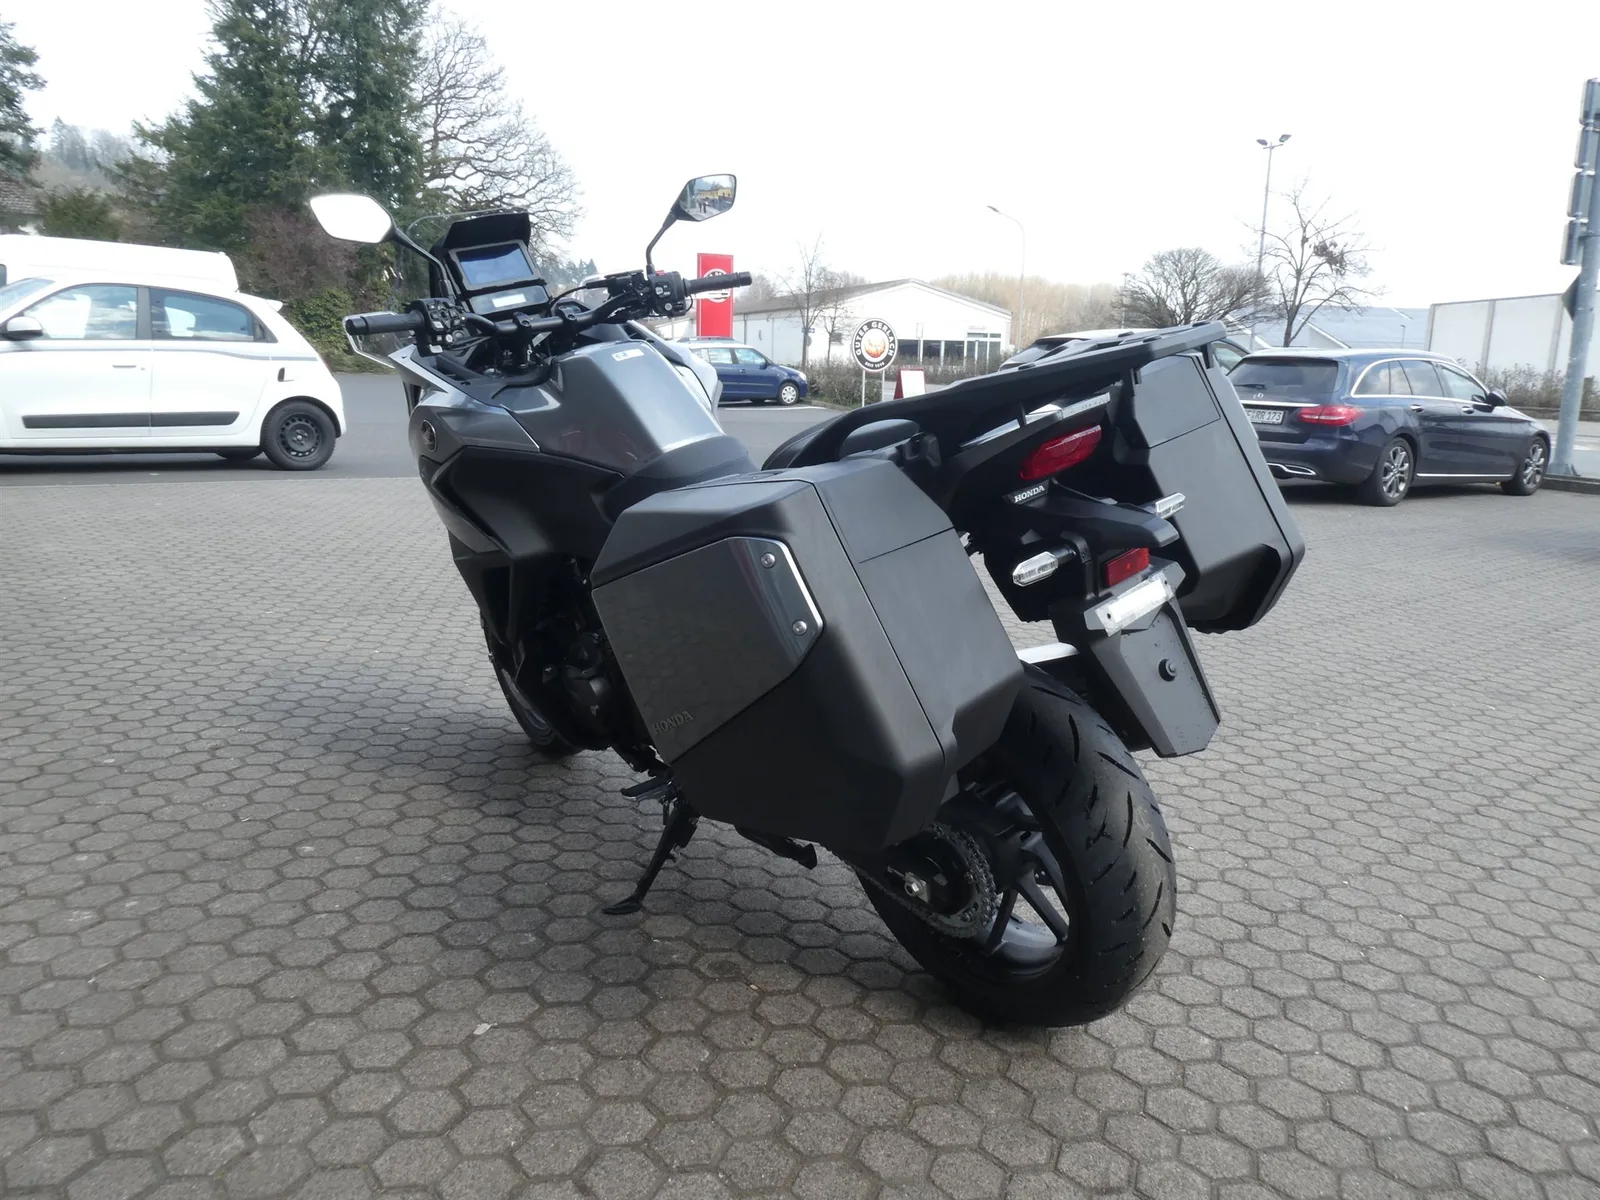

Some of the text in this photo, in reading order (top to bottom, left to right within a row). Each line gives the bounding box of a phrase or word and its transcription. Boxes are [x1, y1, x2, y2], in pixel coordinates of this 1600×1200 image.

[855, 321, 895, 357] GUTER GERLACH
[1014, 485, 1045, 503] HONDA
[651, 710, 695, 736] HONDA
